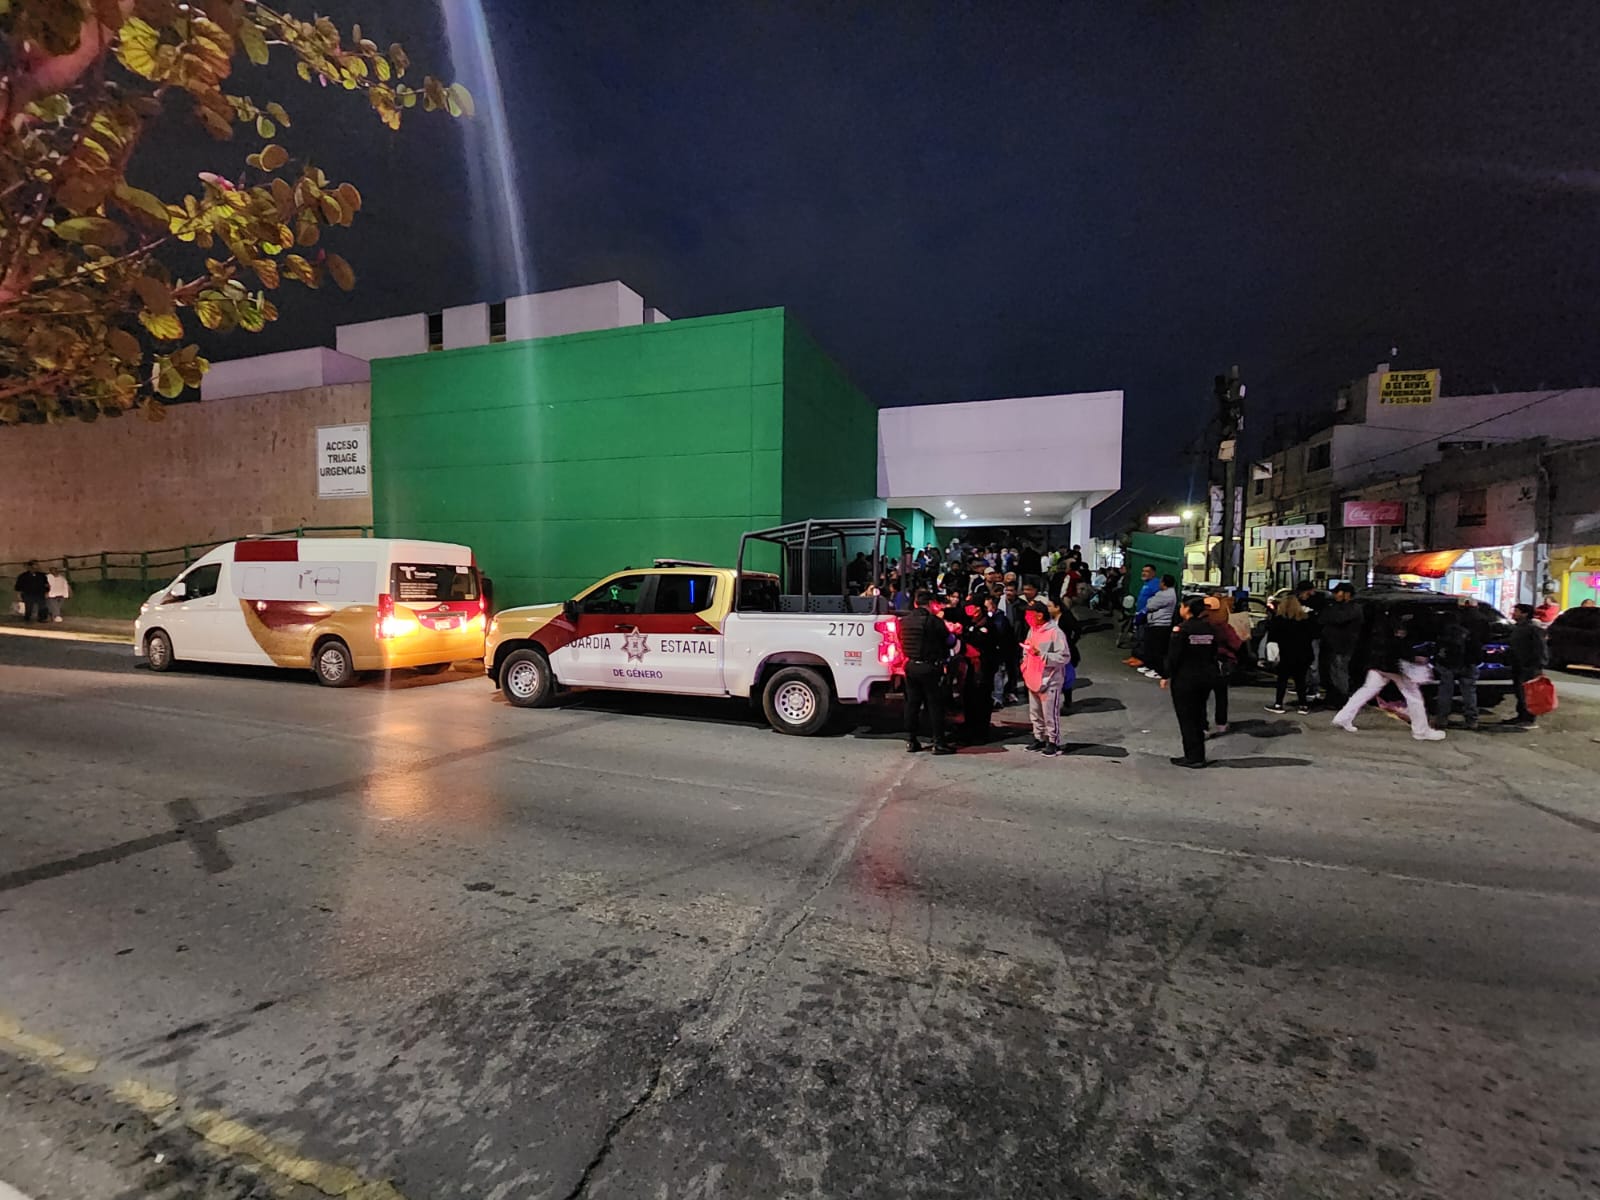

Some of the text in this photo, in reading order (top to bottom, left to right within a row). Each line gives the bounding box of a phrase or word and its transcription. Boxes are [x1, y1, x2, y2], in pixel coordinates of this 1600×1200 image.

[326, 440, 358, 451] ACCESO
[327, 453, 357, 464] TRIAGE
[319, 465, 366, 477] URGENCIAS
[828, 622, 865, 637] 2170
[661, 639, 715, 654] ESTATAL
[612, 668, 625, 678] DE
